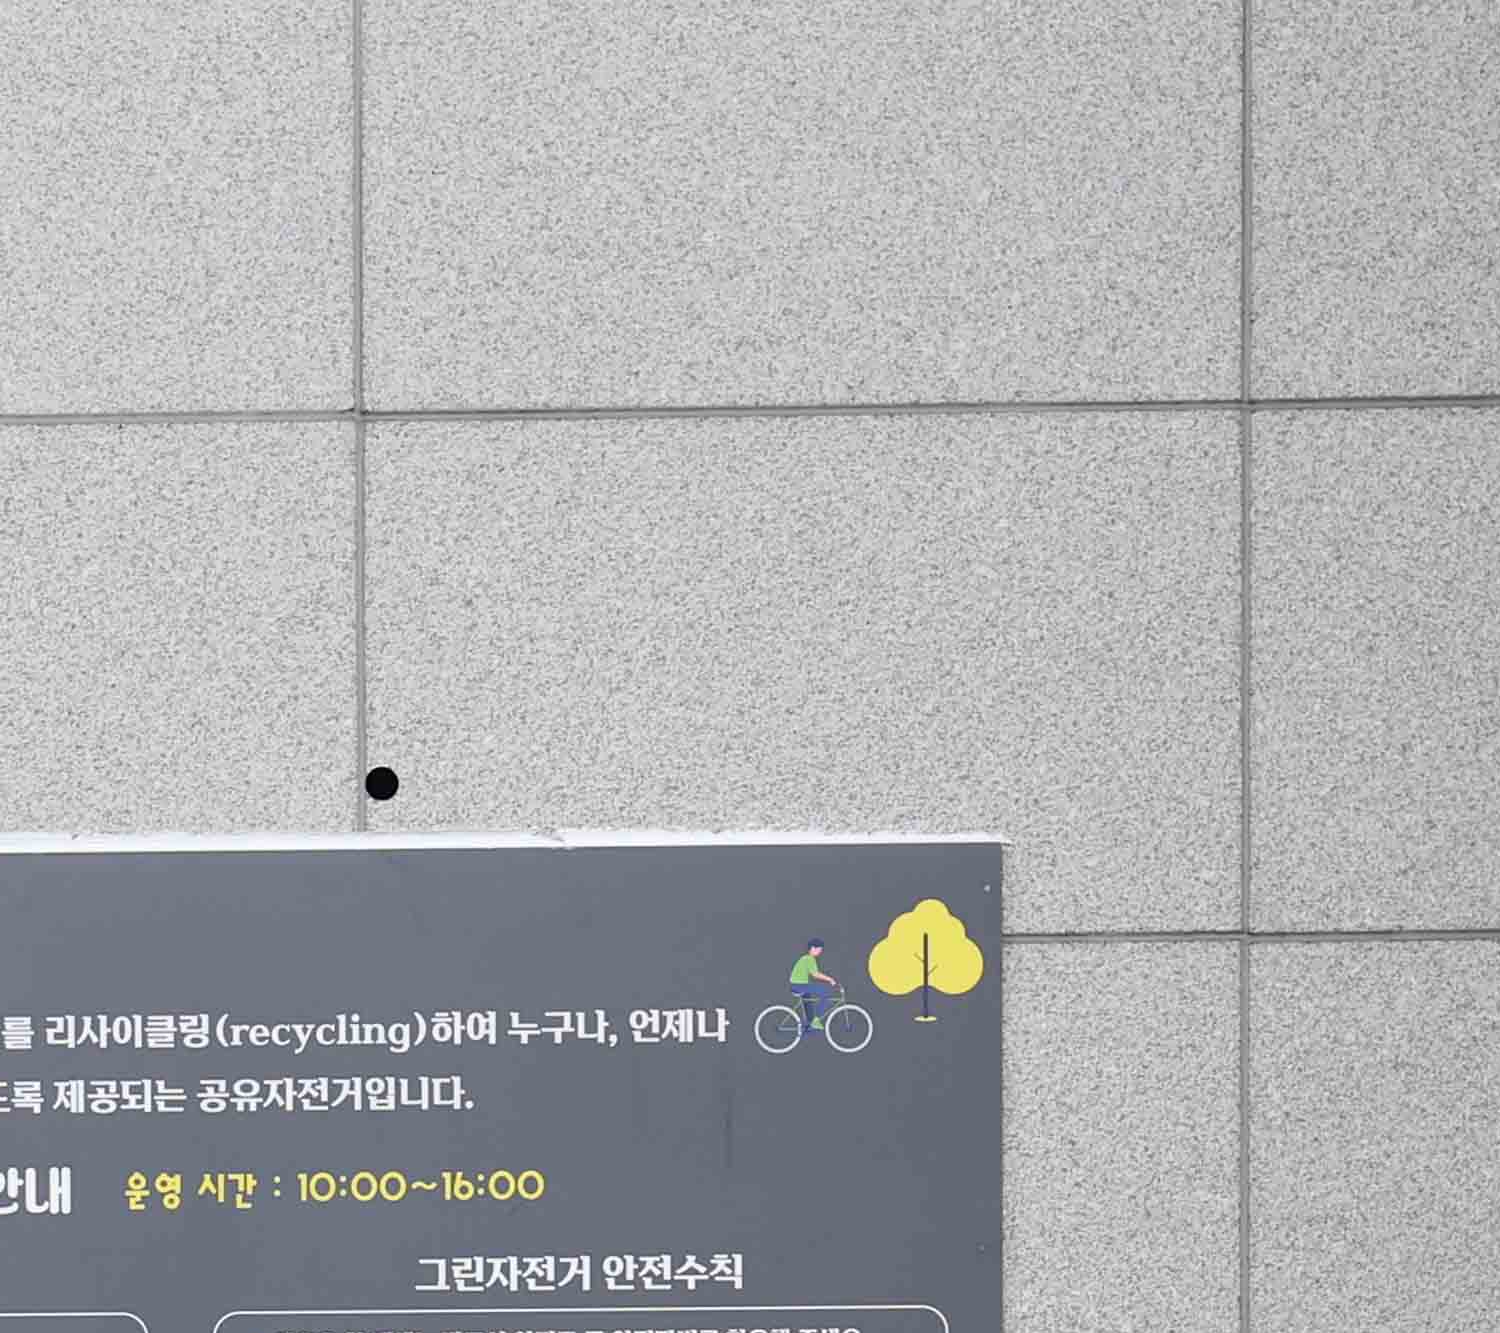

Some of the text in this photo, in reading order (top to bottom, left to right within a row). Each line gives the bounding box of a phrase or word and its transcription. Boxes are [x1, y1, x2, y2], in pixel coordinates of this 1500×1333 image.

[45, 1010, 497, 1055] 리사이클링(recycling)하여
[507, 1009, 618, 1047] 누구나,
[629, 1007, 731, 1043] 언제나
[52, 1078, 188, 1114] 제공되는
[196, 1075, 474, 1113] 공유자전거입니다.
[124, 1171, 182, 1211] 운영
[197, 1173, 258, 1209] 시간
[297, 1170, 545, 1202] 10:00~16:00
[415, 1253, 743, 1292] 그린자전거 안전수칙
